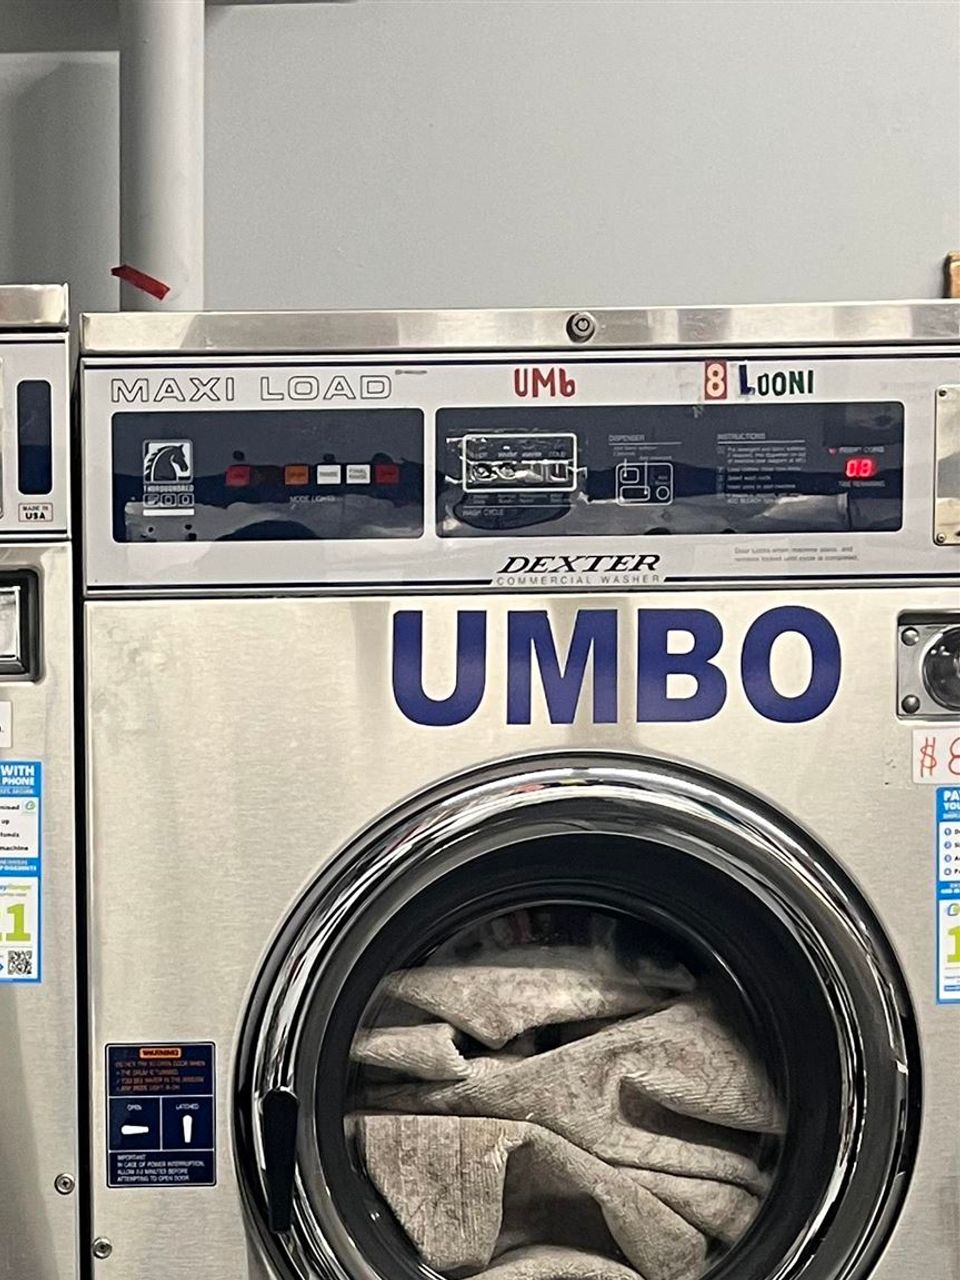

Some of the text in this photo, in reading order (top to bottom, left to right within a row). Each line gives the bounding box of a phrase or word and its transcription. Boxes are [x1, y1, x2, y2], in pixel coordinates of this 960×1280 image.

[111, 375, 392, 402] MAXI LOAD
[705, 362, 726, 398] 8
[496, 554, 661, 574] DEXTER
[496, 574, 660, 586] COMMERCIAL WASHER
[393, 605, 841, 726] UMBO
[0, 764, 35, 776] WITH
[2, 776, 35, 785] PHONE
